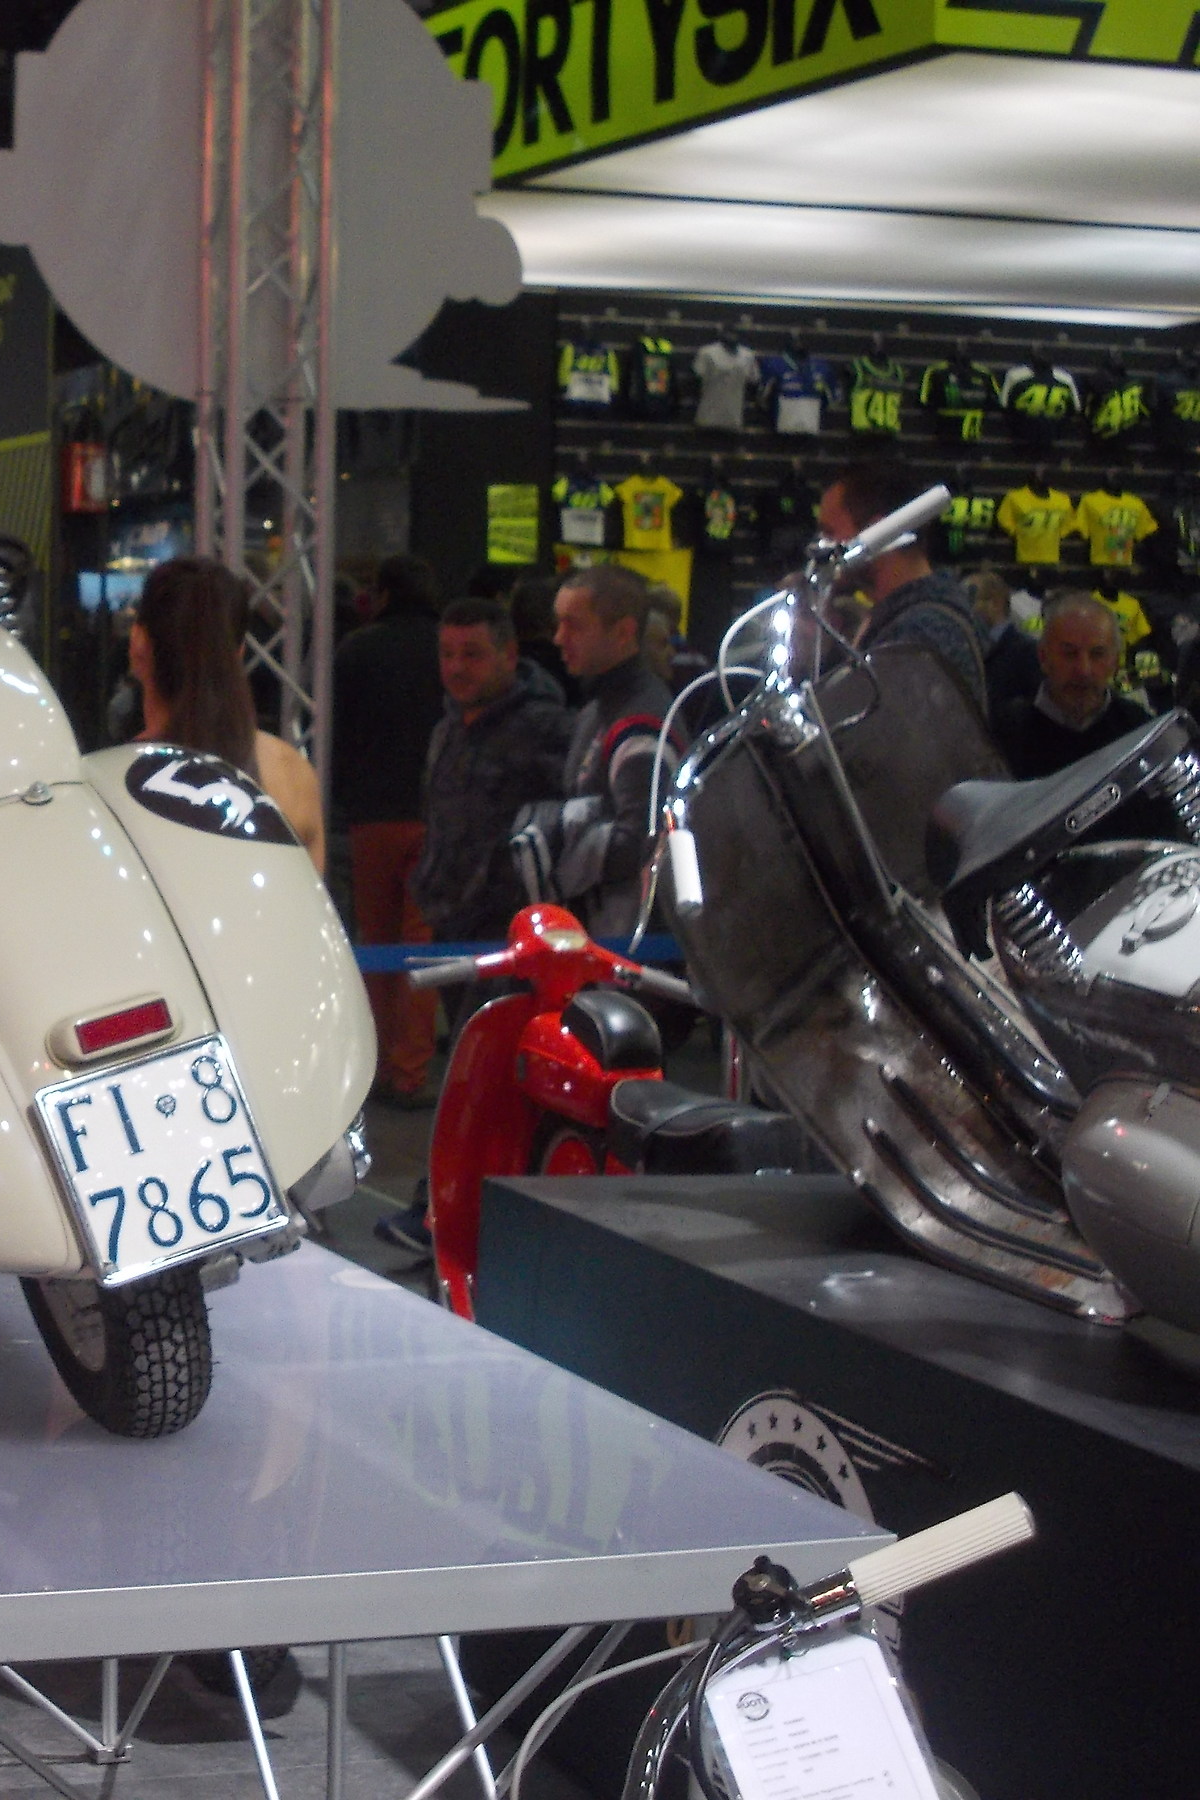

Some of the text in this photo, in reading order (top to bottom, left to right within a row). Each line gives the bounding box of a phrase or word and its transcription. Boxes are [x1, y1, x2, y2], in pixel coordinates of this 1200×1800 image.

[54, 1055, 238, 1173] FI 8
[88, 1144, 271, 1264] 7865
